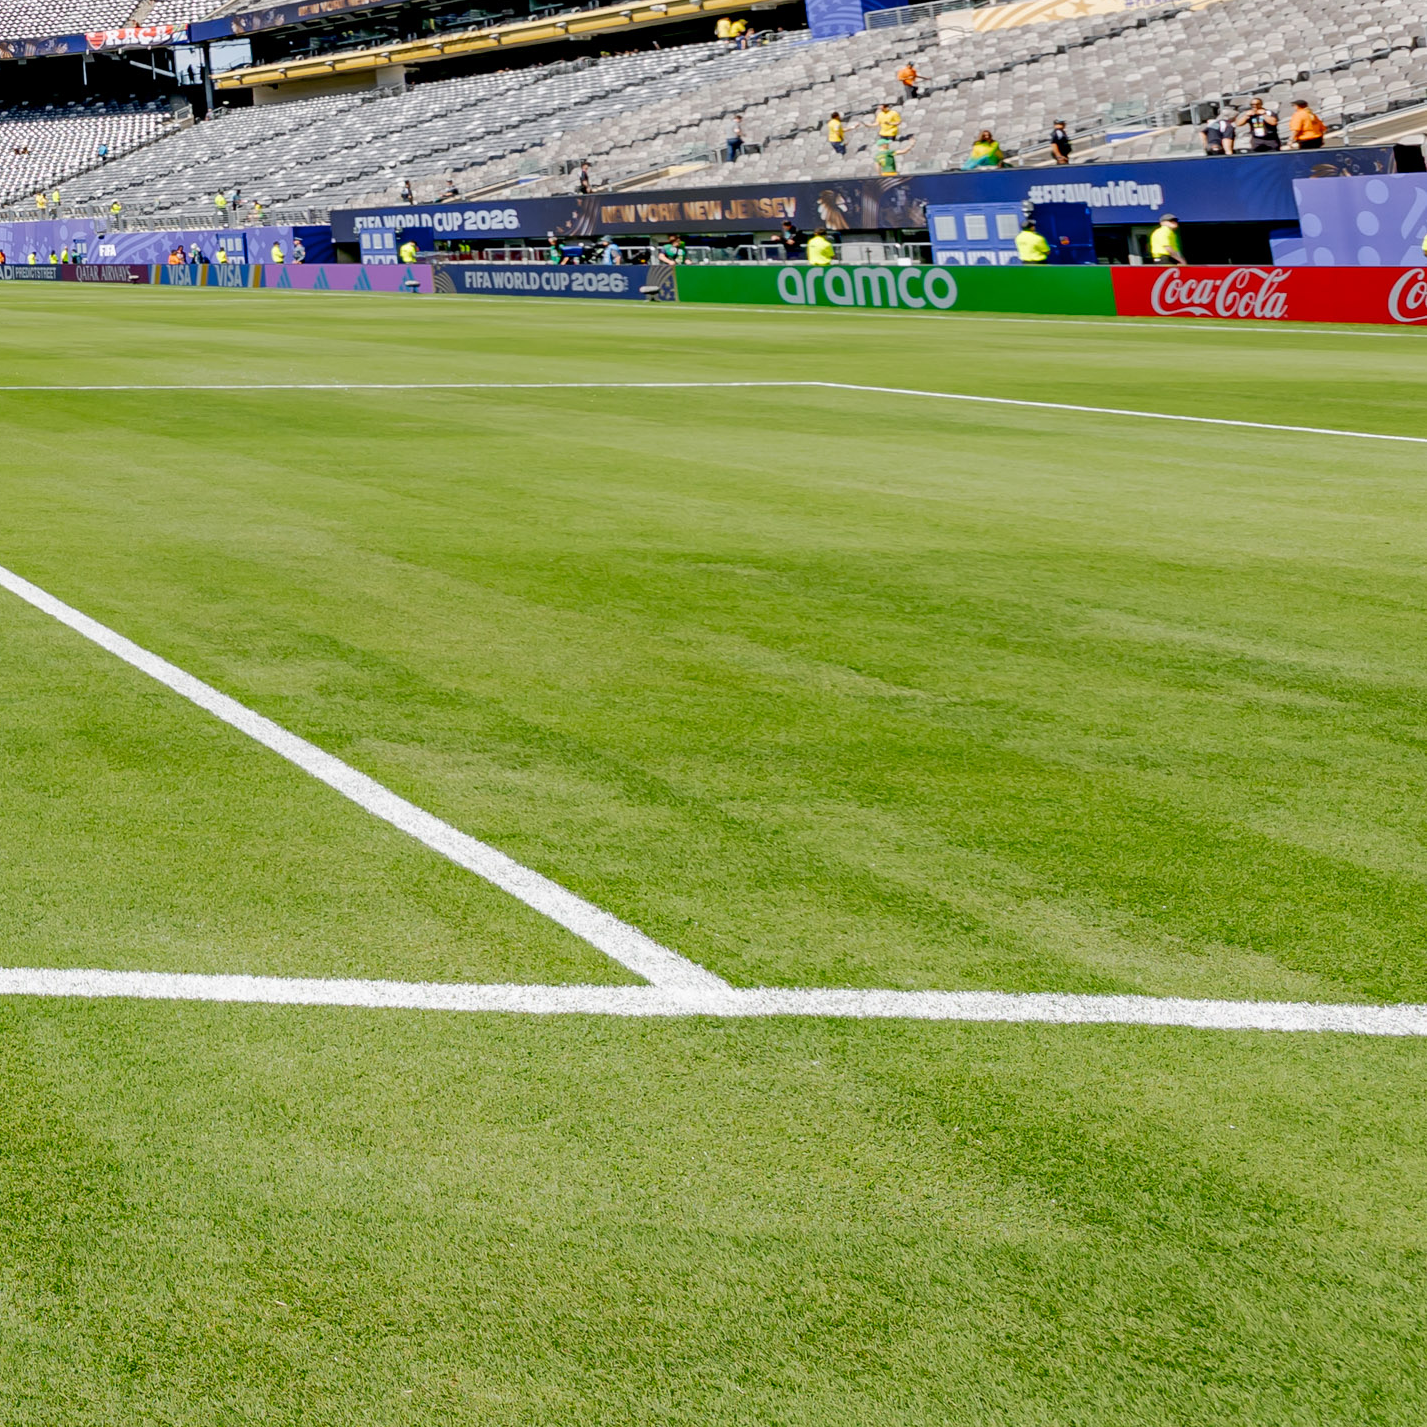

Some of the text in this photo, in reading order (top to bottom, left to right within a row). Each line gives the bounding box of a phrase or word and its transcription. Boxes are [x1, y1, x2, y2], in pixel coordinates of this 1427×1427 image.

[1029, 180, 1163, 210] #FIFAWorldCup
[354, 209, 518, 232] FIFA WORLD CUP 2026
[601, 197, 796, 224] NEW YORK NEW JERSEY
[98, 244, 117, 257] FIFA
[15, 265, 57, 280] PREDICTSTREET
[76, 265, 131, 282] QATAR AIRWAYS
[168, 265, 192, 286] VISA
[214, 265, 243, 287] VISA
[465, 271, 625, 293] FIFA WORLD CUP 2026
[777, 267, 958, 310] aramco
[1150, 267, 1292, 318] Coca-Cola
